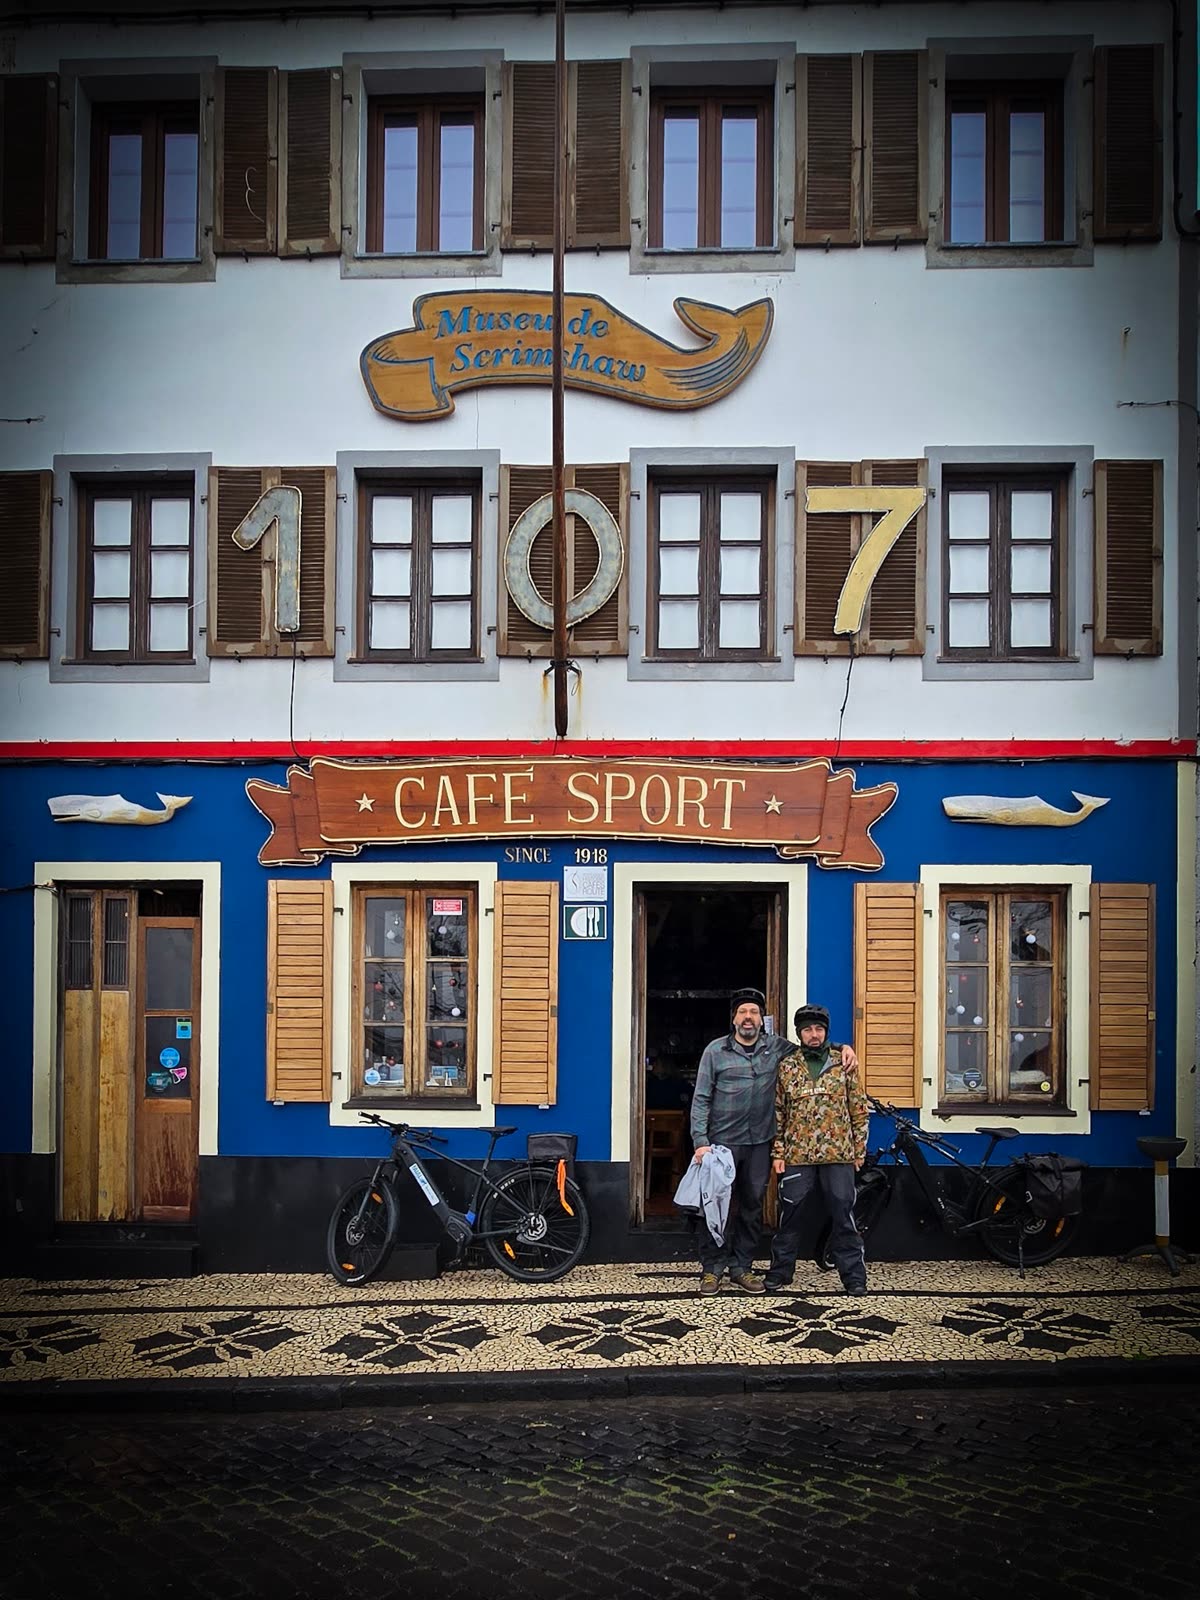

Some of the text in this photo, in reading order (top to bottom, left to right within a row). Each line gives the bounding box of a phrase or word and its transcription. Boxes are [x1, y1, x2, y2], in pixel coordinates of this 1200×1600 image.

[434, 305, 609, 339] Museu de
[566, 771, 747, 831] SPORT
[503, 846, 608, 865] SINCE 1918
